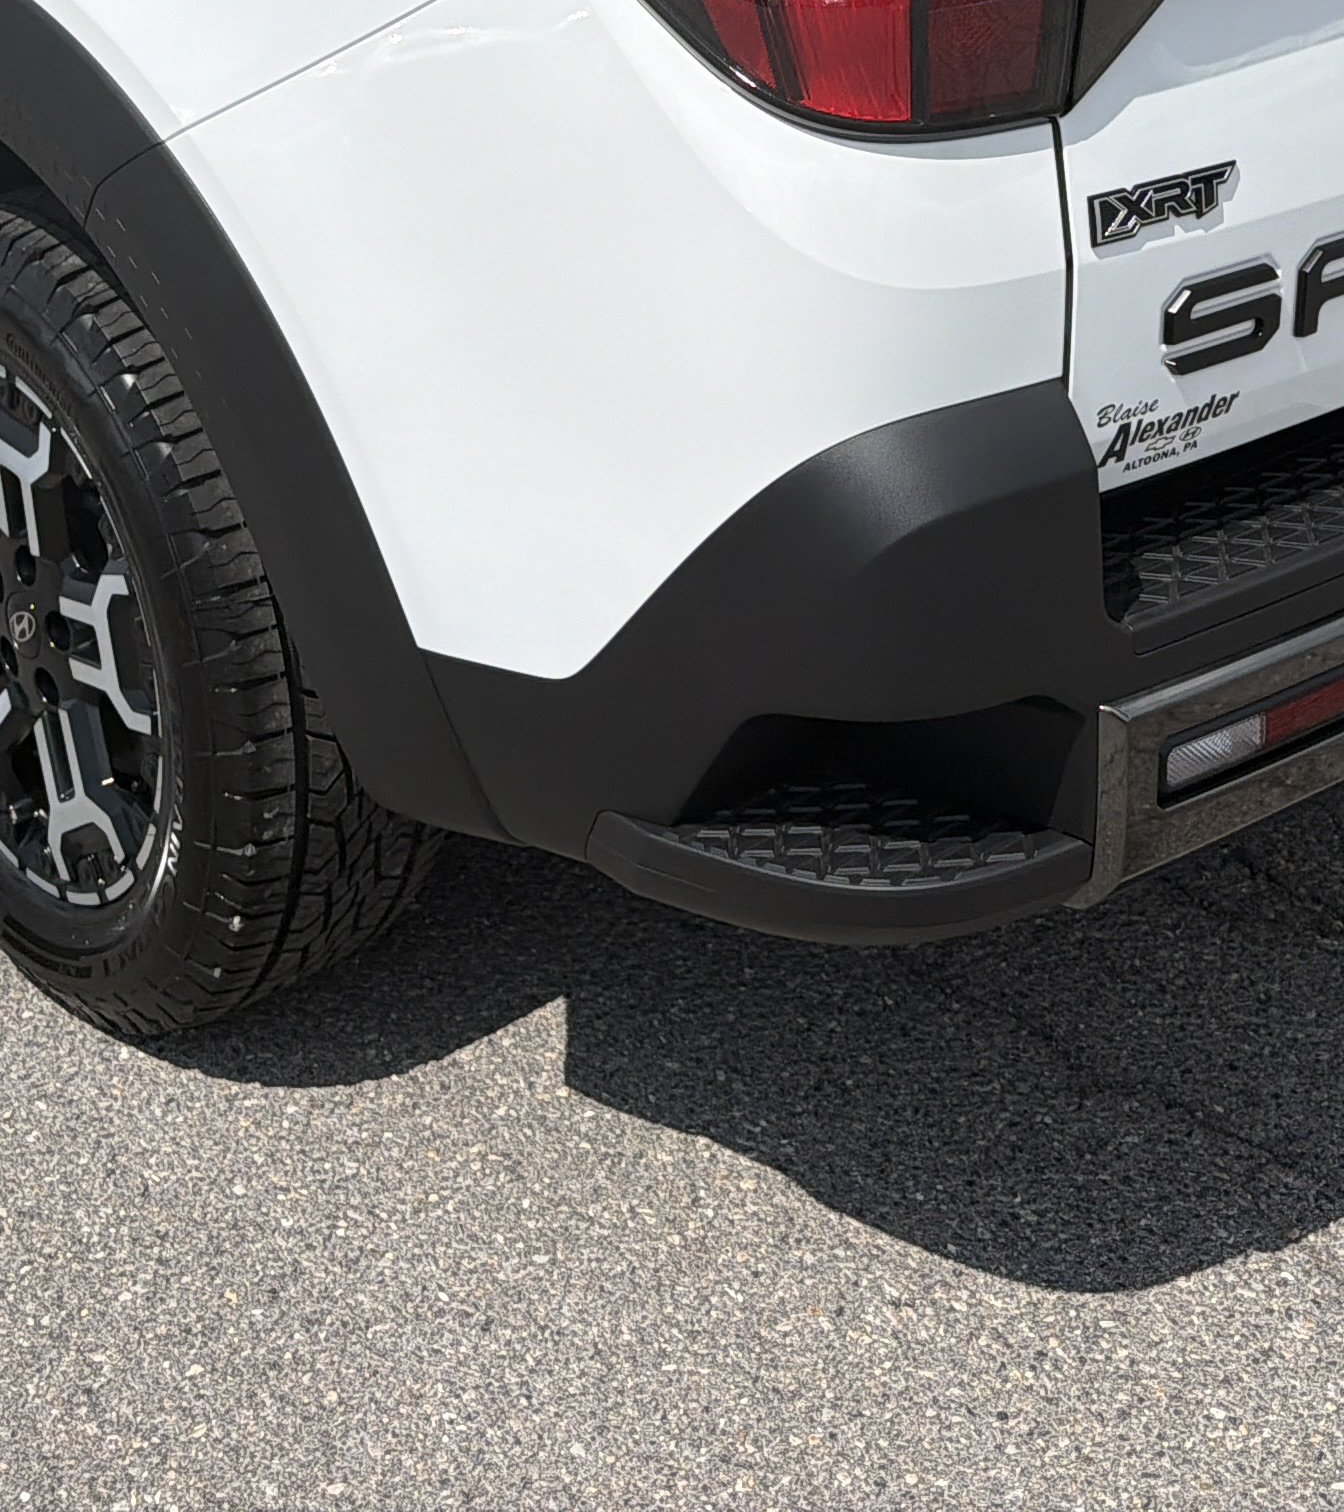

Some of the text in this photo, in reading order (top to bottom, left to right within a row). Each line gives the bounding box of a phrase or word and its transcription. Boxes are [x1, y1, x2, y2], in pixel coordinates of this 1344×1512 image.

[1087, 159, 1238, 249] XRT
[1095, 390, 1241, 469] Alexander
[1096, 398, 1160, 429] Blaise
[1122, 439, 1199, 473] ALTOONA, PA
